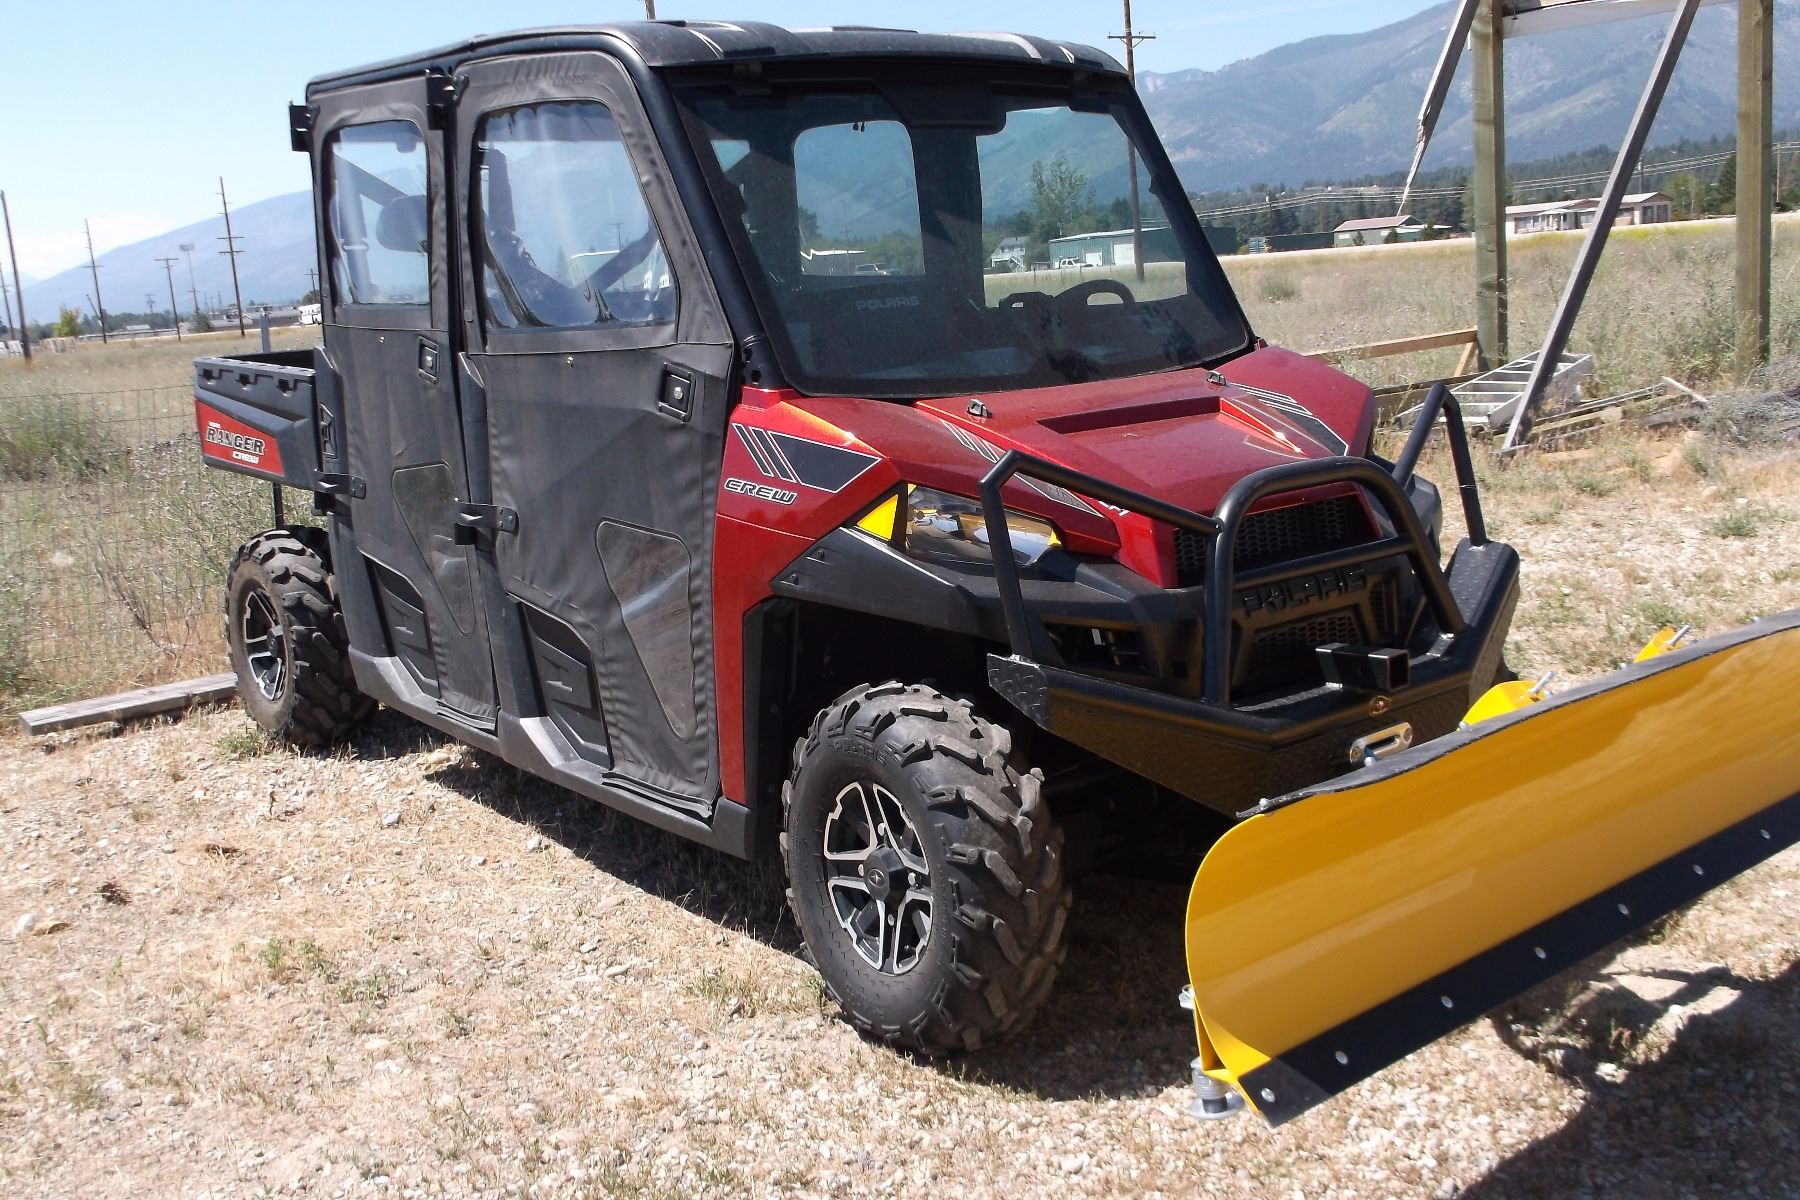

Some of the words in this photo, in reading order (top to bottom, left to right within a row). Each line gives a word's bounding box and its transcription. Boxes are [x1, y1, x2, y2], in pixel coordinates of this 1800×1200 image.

[856, 295, 920, 311] POLARIS
[206, 426, 265, 455] RANGER
[233, 451, 259, 464] CREW
[724, 478, 797, 505] CREW
